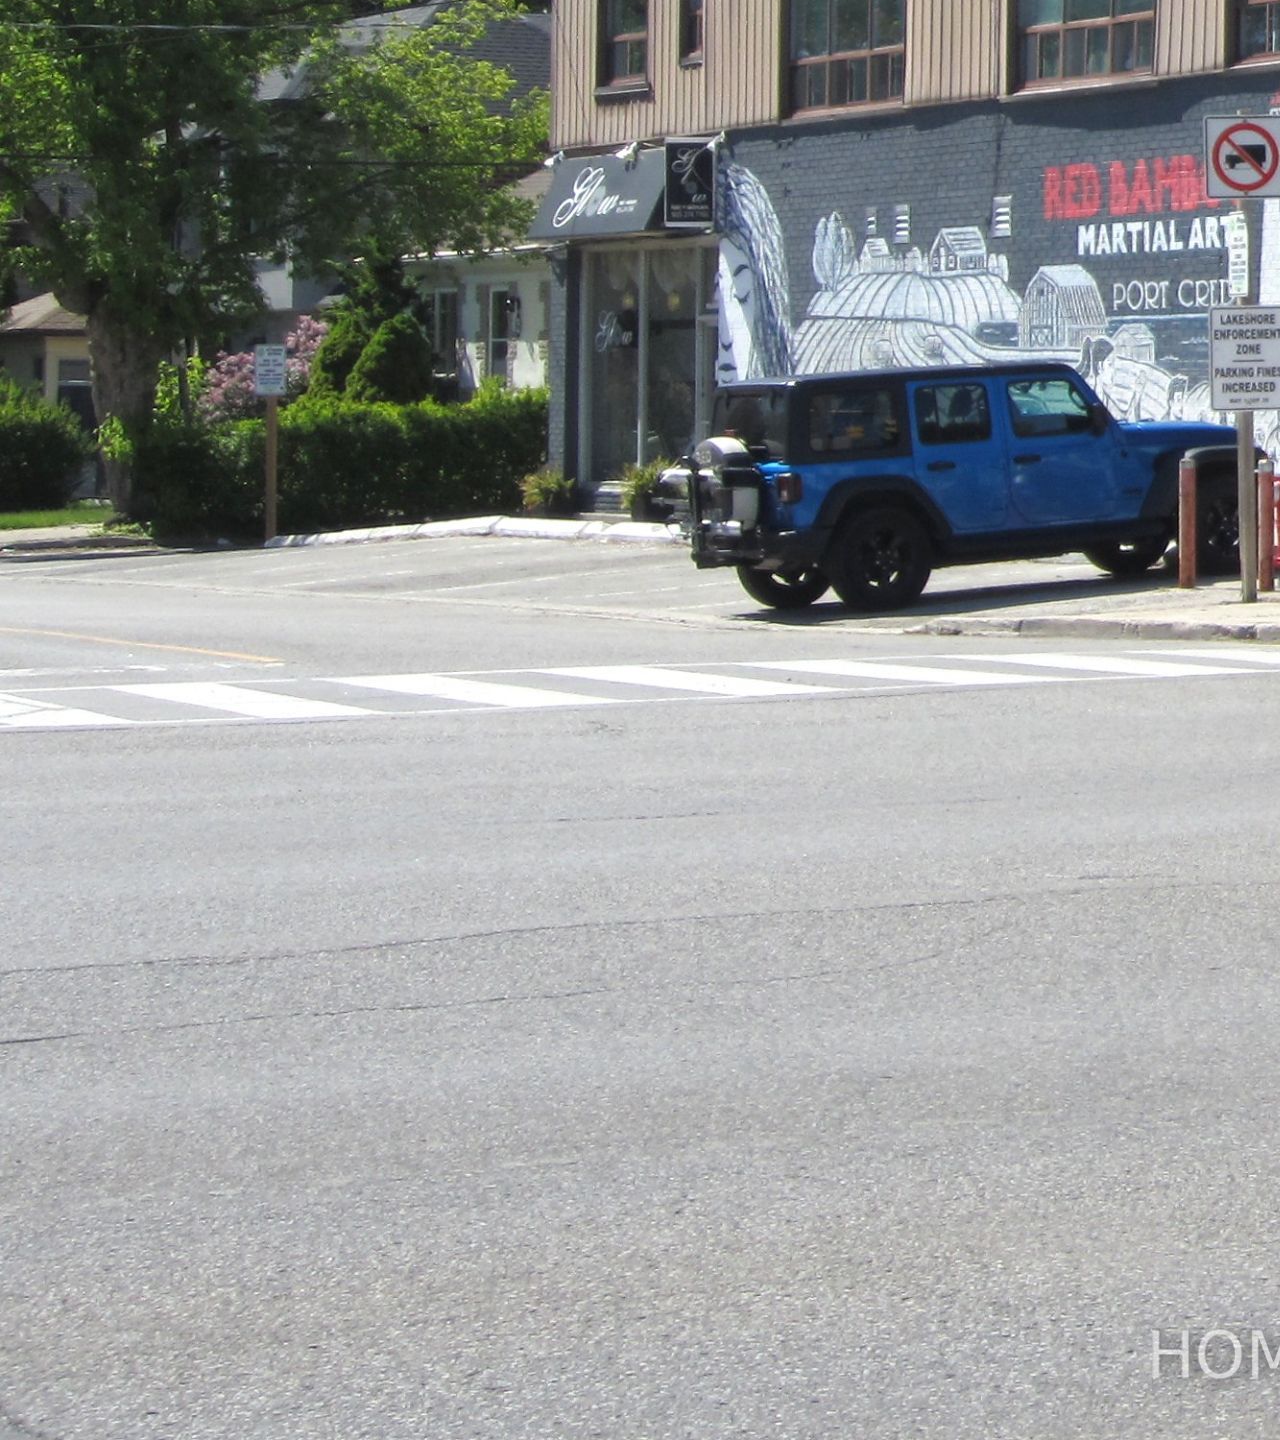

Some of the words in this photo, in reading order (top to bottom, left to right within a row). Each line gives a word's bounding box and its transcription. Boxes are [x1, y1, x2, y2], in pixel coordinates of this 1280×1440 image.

[1042, 162, 1101, 221] RED
[1108, 153, 1238, 218] BAMB
[1077, 220, 1183, 256] MARTIAL
[1188, 213, 1236, 250] ART
[1113, 281, 1169, 311] PORT
[1220, 314, 1275, 325] LAKESHORE
[1236, 344, 1261, 354] ZONE
[1215, 367, 1254, 378] PARKING
[1222, 382, 1276, 393] INCREASED
